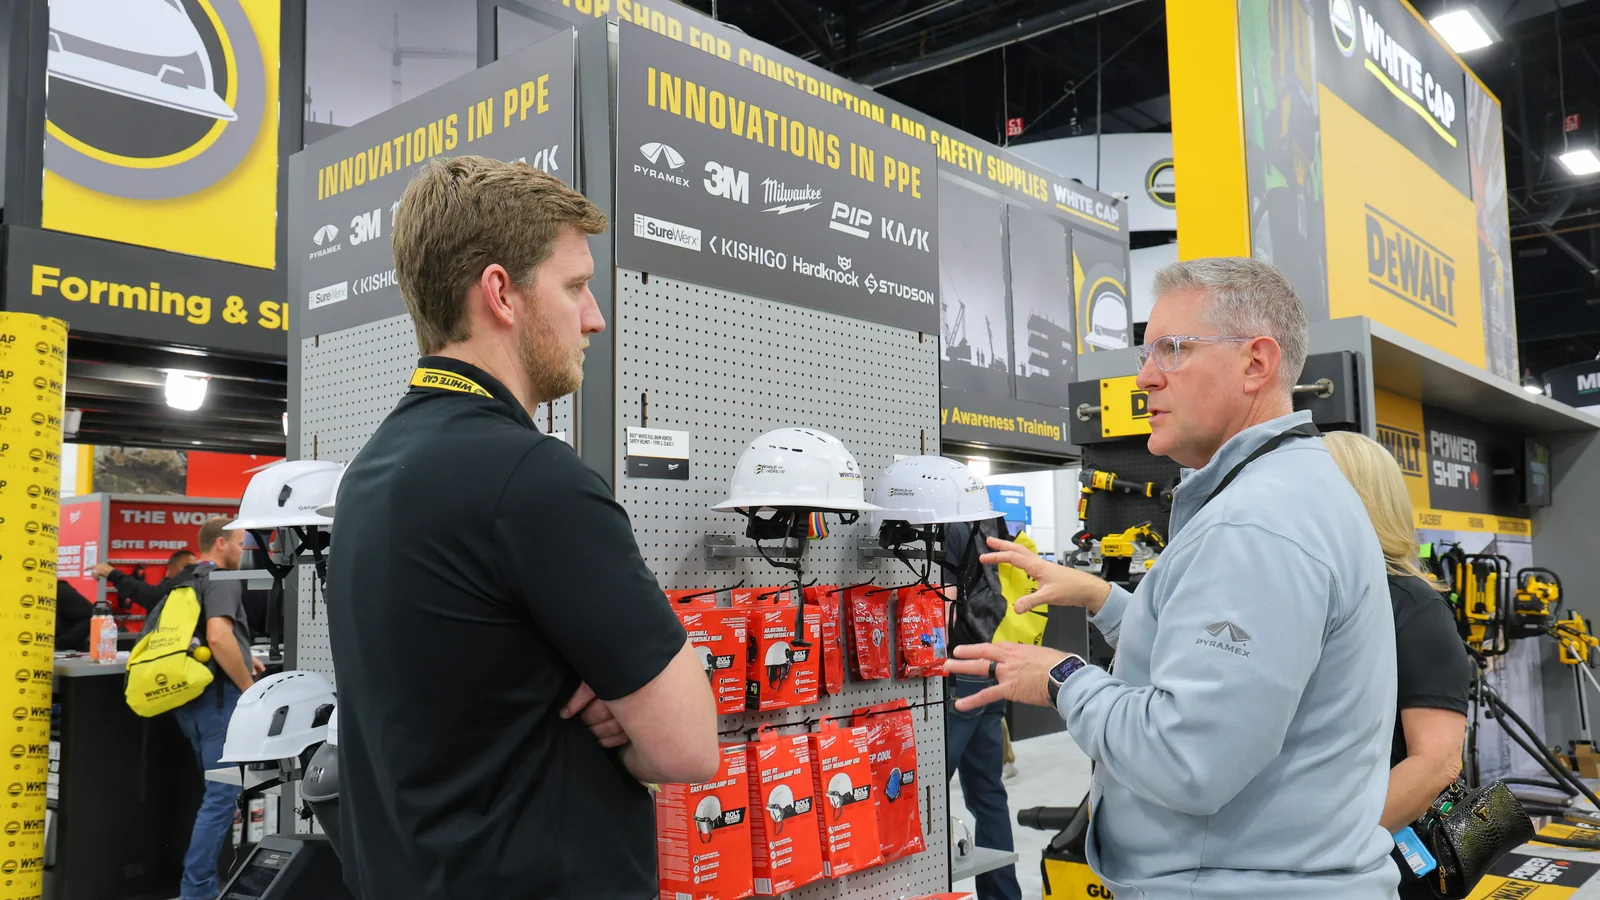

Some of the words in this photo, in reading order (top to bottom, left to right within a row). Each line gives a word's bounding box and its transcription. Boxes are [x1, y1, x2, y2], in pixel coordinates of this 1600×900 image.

[1359, 5, 1424, 100] WHITE
[1424, 72, 1456, 128] CAP
[318, 112, 458, 200] INNOVATIONS
[468, 98, 494, 142] IN
[504, 74, 550, 128] PPE
[648, 67, 840, 170] INNOVATIONS
[850, 142, 874, 182] IN
[884, 155, 922, 200] PPE
[931, 130, 983, 175] SAFETY
[987, 155, 1048, 202] SUPPLIES
[1053, 183, 1094, 216] WHITE
[1095, 201, 1120, 223] CAP
[634, 164, 690, 188] PYRAMEX
[704, 160, 750, 205] 3M
[760, 177, 823, 204] Milwaukee
[831, 201, 872, 227] PIP
[882, 217, 930, 252] KASK
[309, 244, 342, 260] PYRAMEX
[350, 208, 382, 246] 3M
[647, 222, 699, 246] SureWerx
[721, 237, 788, 270] KISHIGO
[792, 255, 860, 288] Hardknock
[878, 280, 934, 305] STUDSON
[32, 264, 212, 325] Forming
[222, 296, 248, 326] &
[258, 300, 289, 330] S
[316, 287, 346, 304] SureWerx
[0, 333, 16, 344] AP
[0, 369, 14, 380] AP
[422, 374, 438, 384] CAP
[438, 378, 474, 392] WHITE
[1131, 393, 1148, 416] D
[940, 408, 948, 425] y
[952, 406, 1014, 432] Awareness
[1016, 417, 1060, 441] Training
[1377, 428, 1420, 472] WALT
[1430, 430, 1478, 464] POWER
[1432, 460, 1470, 490] SHIFT
[120, 510, 166, 524] THE
[112, 540, 144, 549] SITE
[149, 540, 188, 550] PREP
[1196, 638, 1250, 658] PYRAMEX
[144, 687, 170, 698] WHITE
[171, 681, 188, 690] CAP
[877, 750, 891, 761] COOL
[902, 772, 913, 780] BOLT
[690, 785, 702, 793] EASY
[703, 780, 727, 791] HEADLAMP
[854, 786, 868, 795] BOLT
[796, 798, 810, 807] BOLT
[726, 810, 740, 818] BOLT
[1508, 858, 1552, 880] POWER
[1532, 864, 1568, 882] SHIFT
[1087, 884, 1114, 899] GU
